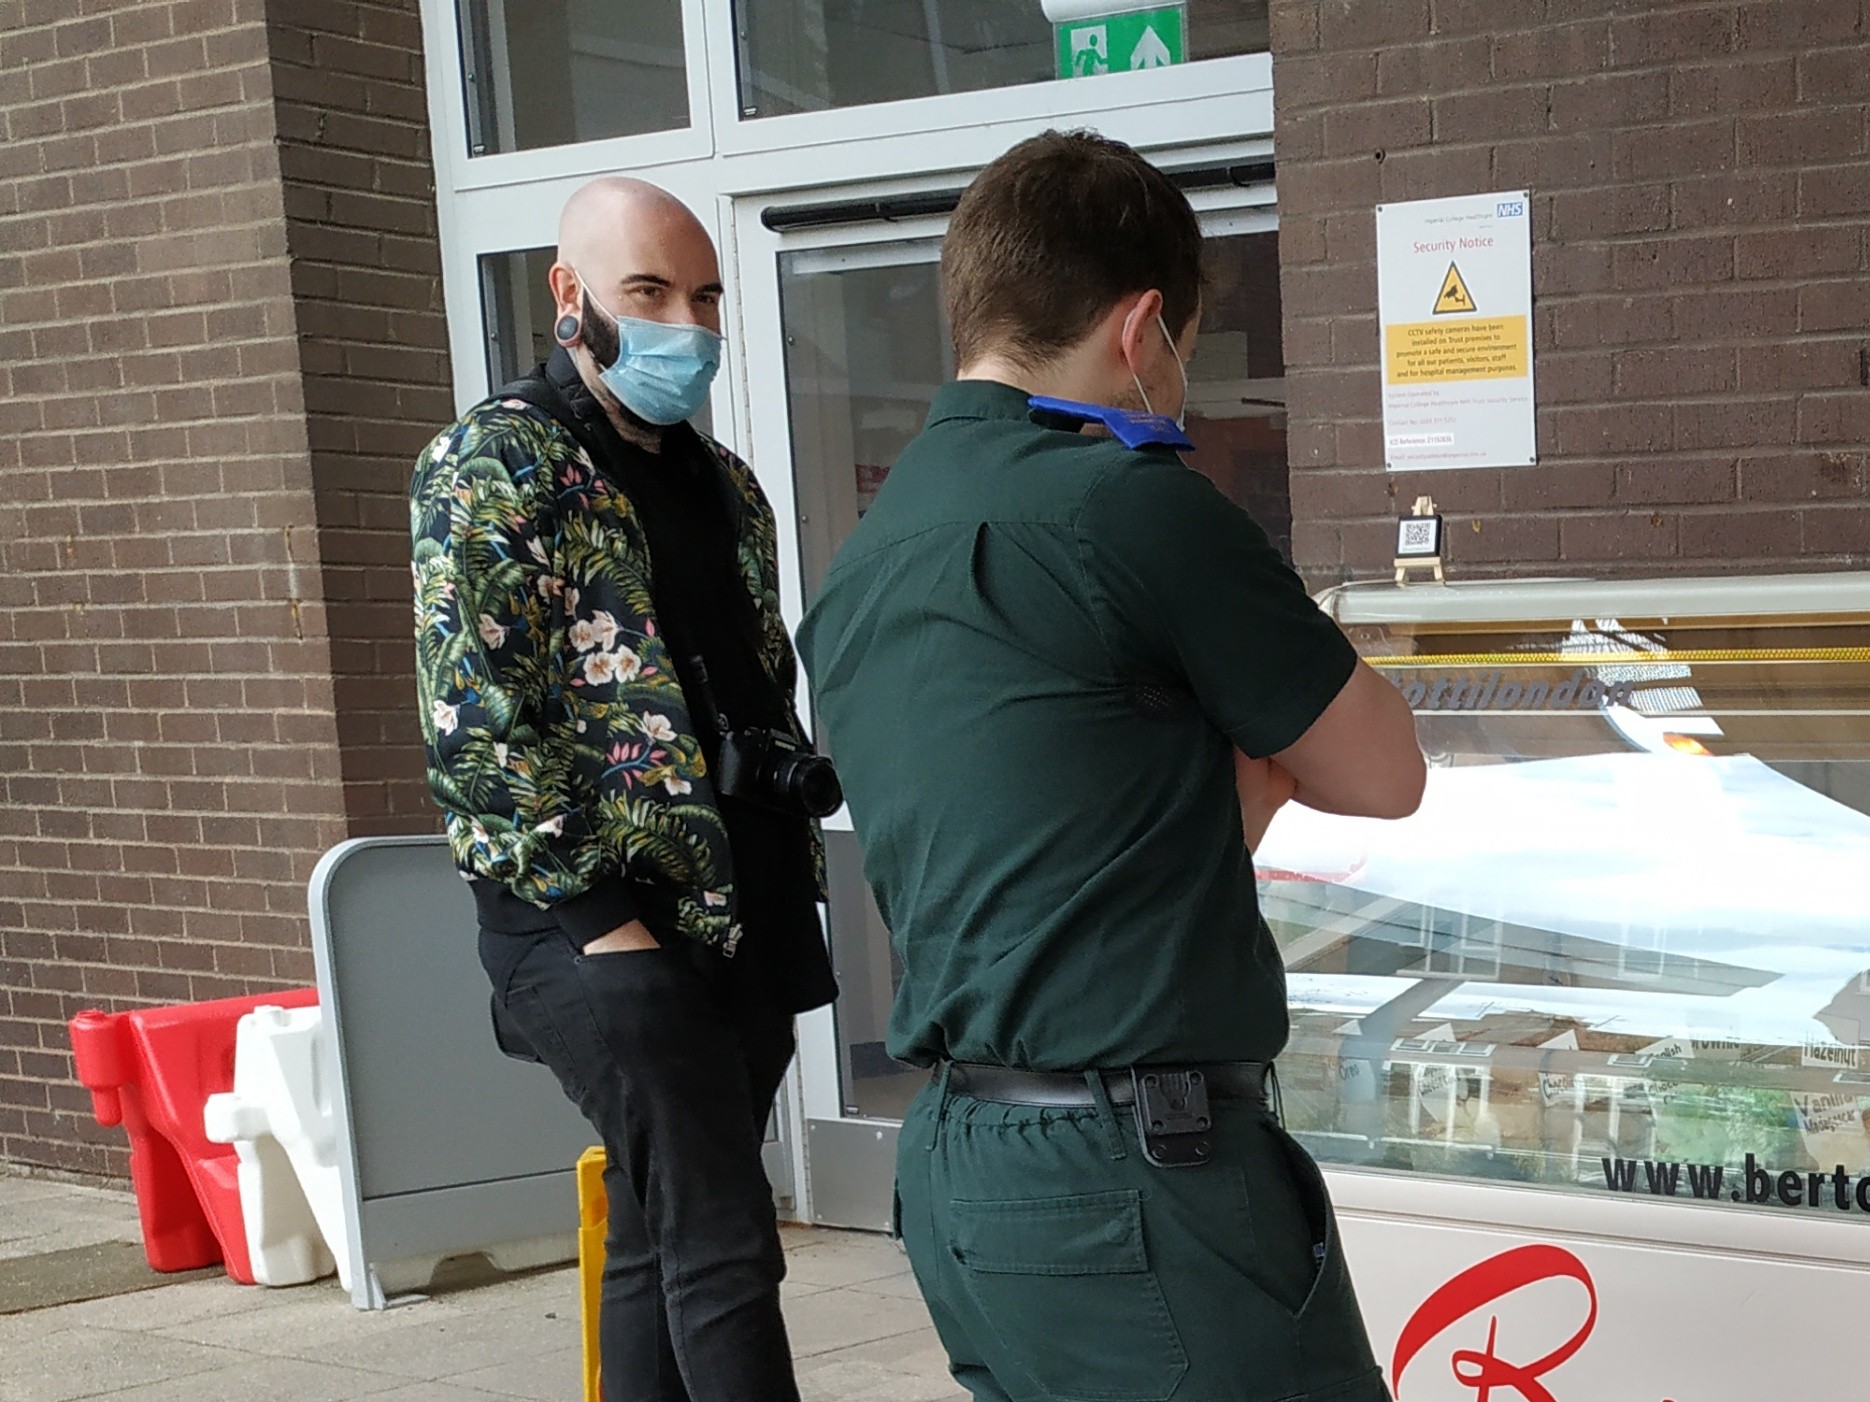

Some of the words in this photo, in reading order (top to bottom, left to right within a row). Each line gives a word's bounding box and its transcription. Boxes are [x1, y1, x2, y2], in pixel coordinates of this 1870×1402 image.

[1498, 203, 1522, 217] NHS
[1413, 239, 1456, 253] Security
[1459, 235, 1494, 249] Notice
[1394, 669, 1635, 710] ottilondon
